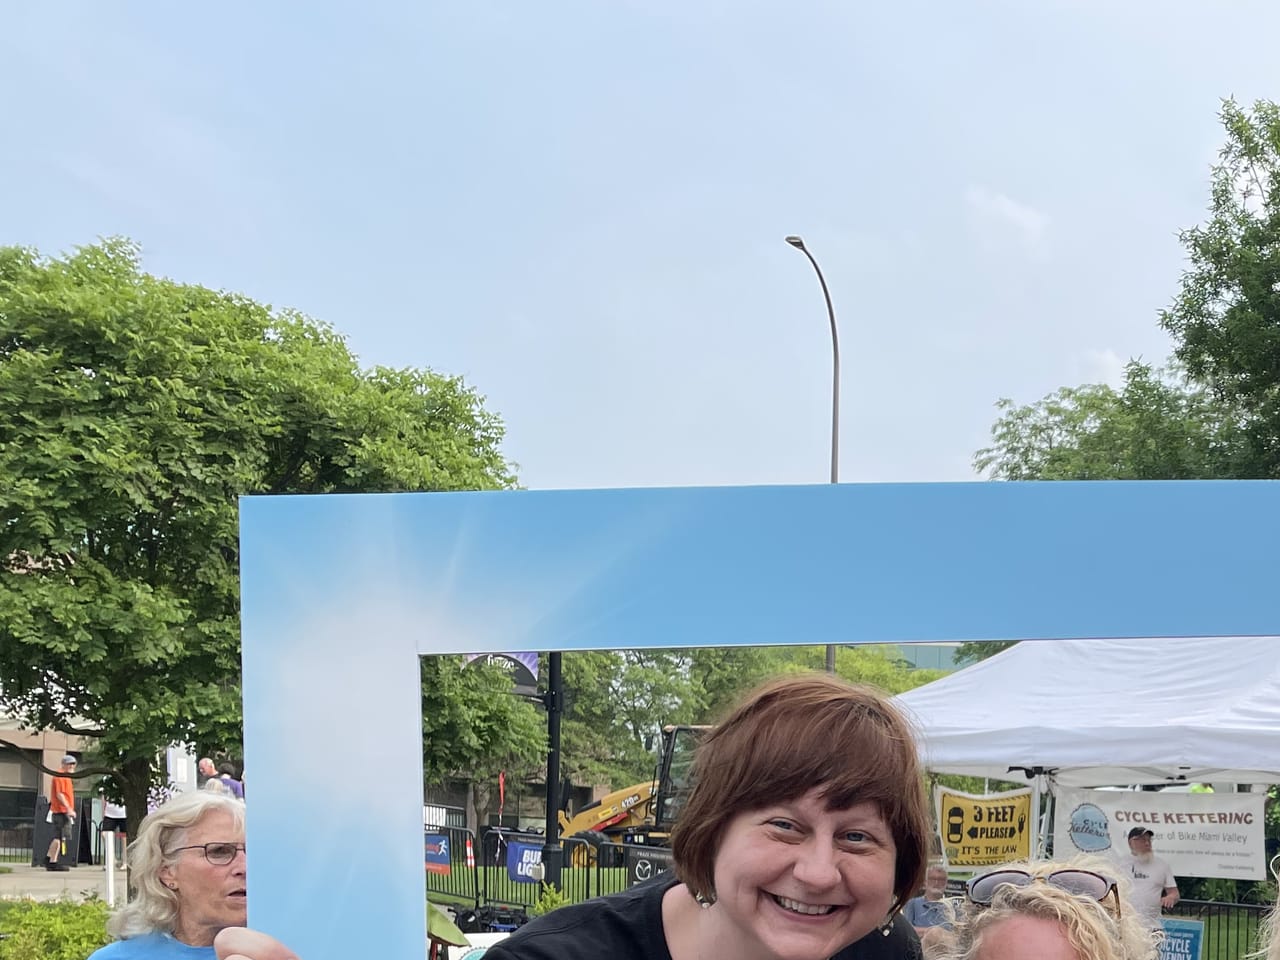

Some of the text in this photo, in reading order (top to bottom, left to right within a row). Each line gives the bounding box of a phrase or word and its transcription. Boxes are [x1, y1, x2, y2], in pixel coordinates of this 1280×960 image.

[973, 805, 1016, 822] 3 FEET
[1114, 810, 1254, 825] CYCLE KETTERING
[979, 826, 1009, 839] PLEASE
[1178, 831, 1197, 841] Bike
[1222, 831, 1248, 845] Valley
[985, 846, 999, 855] THE
[1001, 844, 1017, 854] LAW
